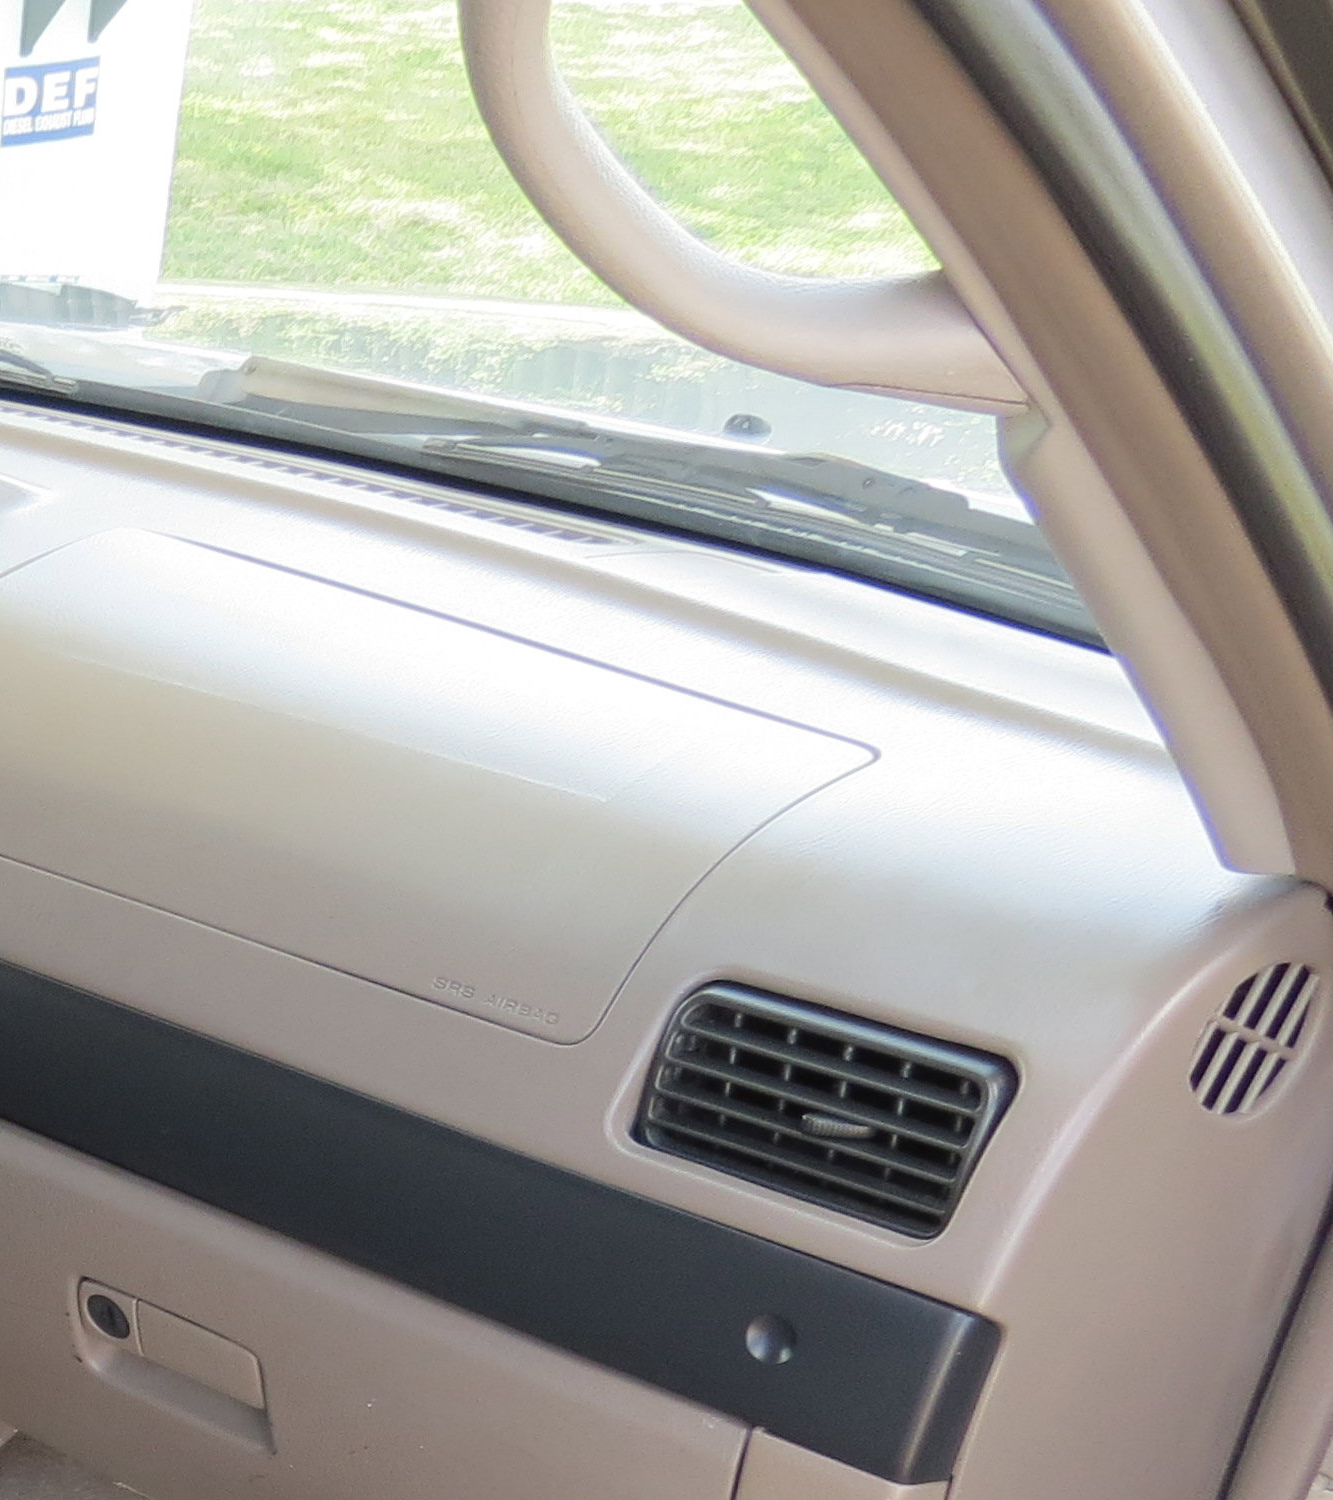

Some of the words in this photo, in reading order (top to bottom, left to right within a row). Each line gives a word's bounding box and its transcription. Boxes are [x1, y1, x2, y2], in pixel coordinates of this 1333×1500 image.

[3, 67, 99, 116] DEF
[433, 976, 476, 999] SRS
[484, 992, 559, 1026] AIRBAG
